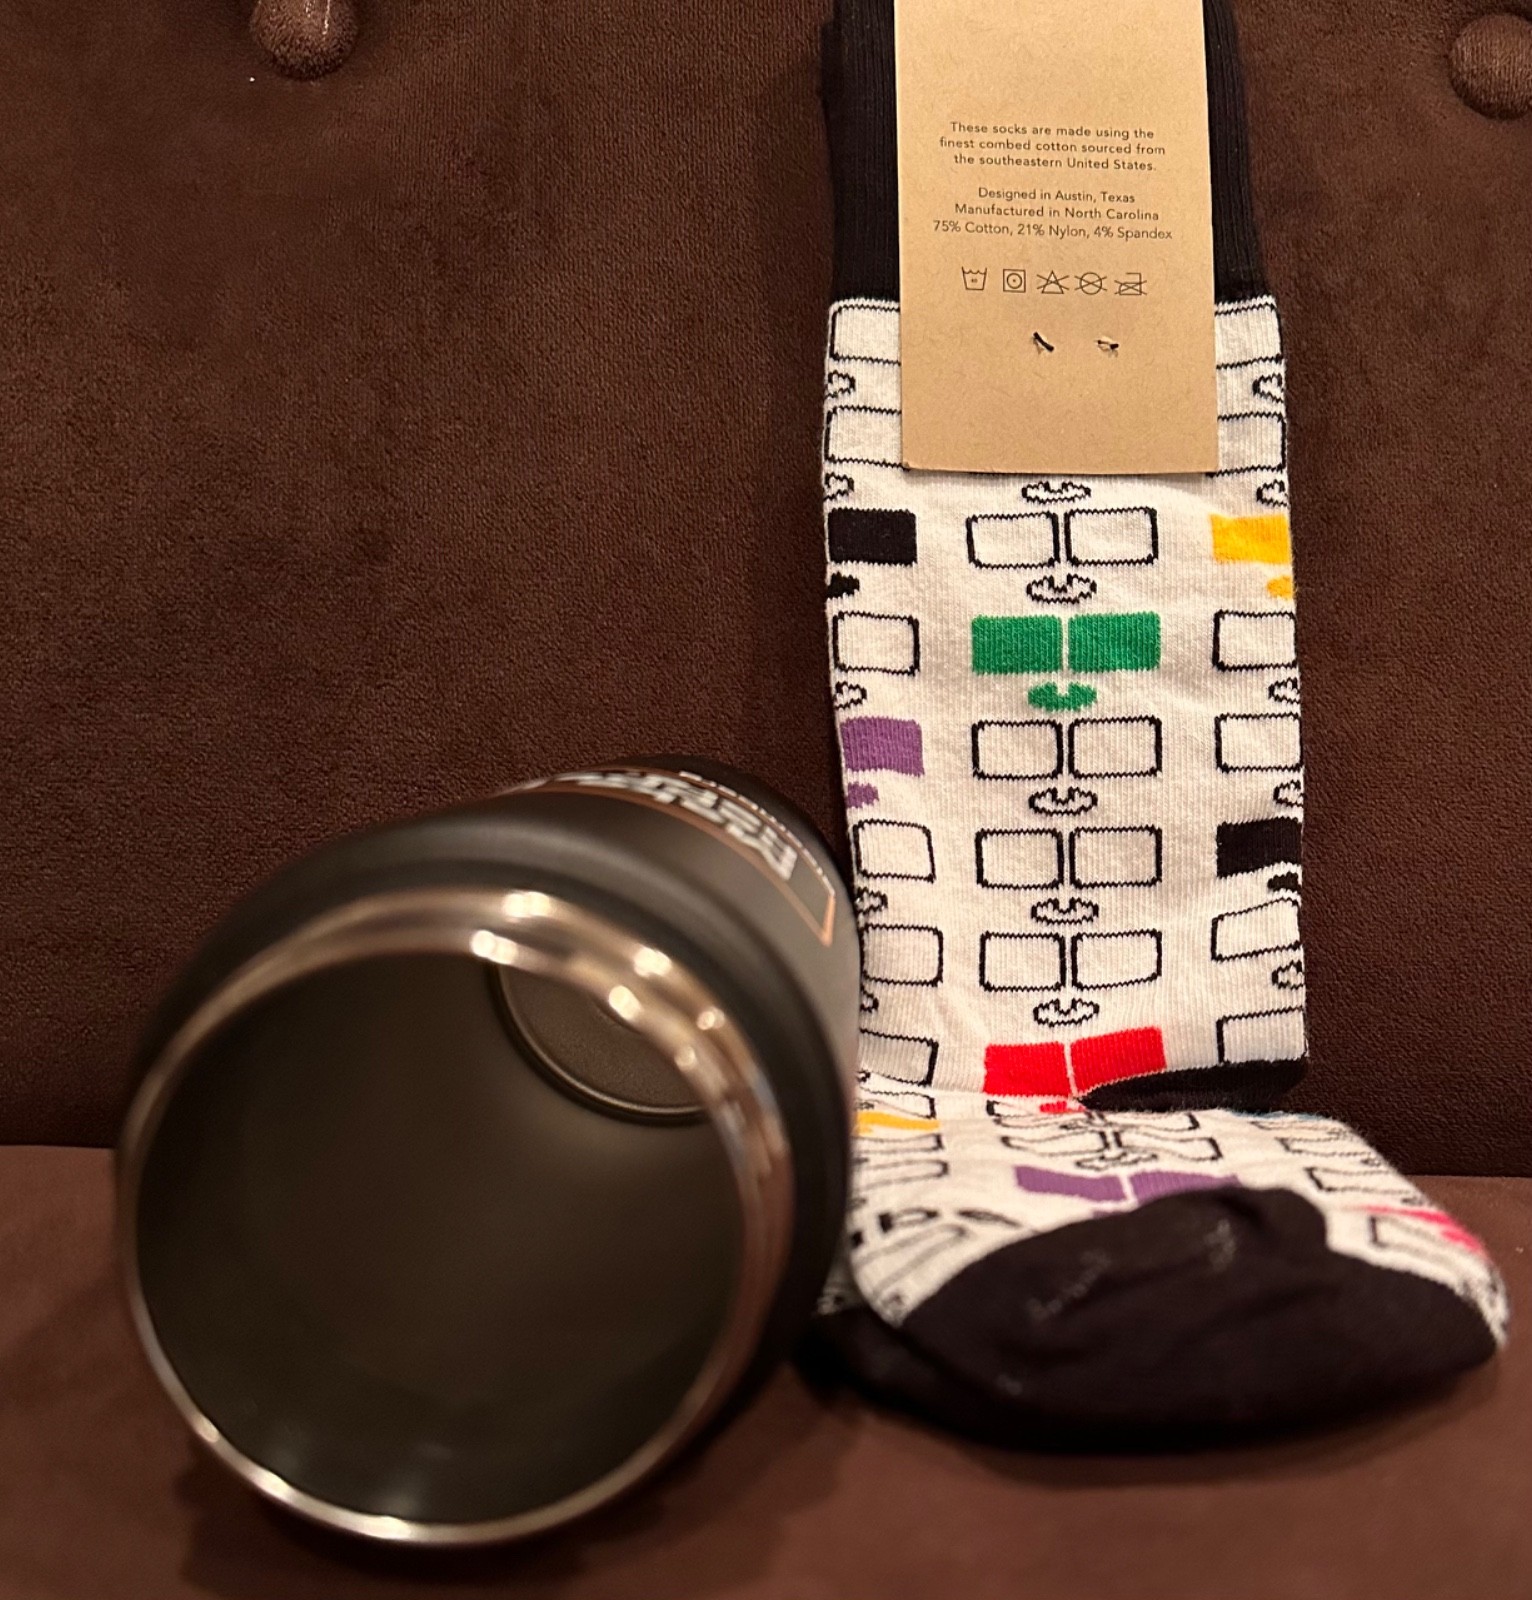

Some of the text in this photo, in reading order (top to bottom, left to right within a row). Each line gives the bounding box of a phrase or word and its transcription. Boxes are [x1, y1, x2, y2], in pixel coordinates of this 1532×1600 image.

[950, 121, 1154, 141] These socks are made using the
[940, 136, 1165, 156] finest combed cotton sourced from
[954, 153, 1156, 172] the southeastern United States.
[979, 187, 1135, 204] Designed in Austin, Texas
[955, 203, 1158, 221] Manufactured in North Carolina
[933, 220, 1172, 243] 75% Cotton, 21% Nylon, 4% Spandex
